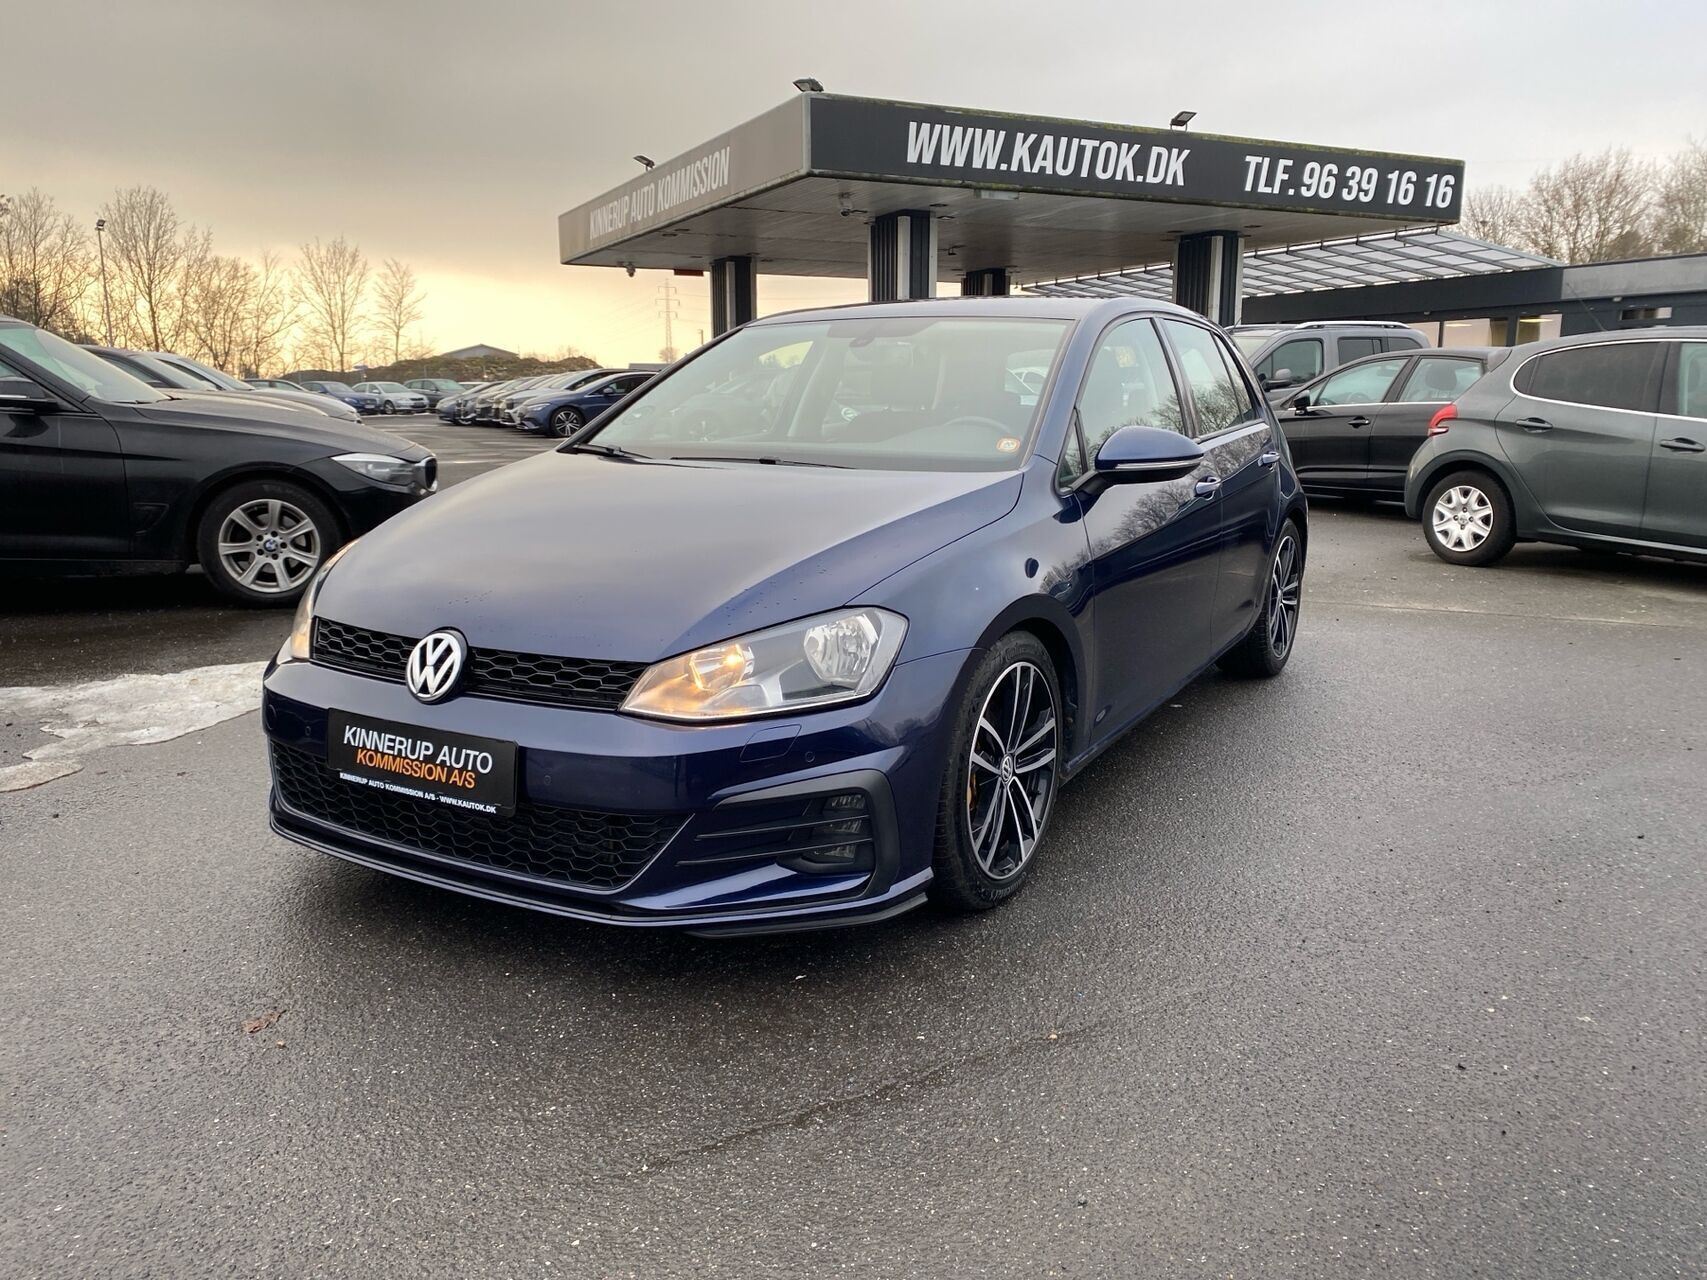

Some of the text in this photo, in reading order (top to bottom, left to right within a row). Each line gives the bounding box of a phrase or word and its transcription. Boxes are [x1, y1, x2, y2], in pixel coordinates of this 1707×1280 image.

[907, 121, 1191, 186] WWW.KAUTOK.DK
[590, 146, 730, 240] KINNERUP AUTO KOMMISSION
[1244, 155, 1456, 208] TLF. 96 39 16 16
[343, 725, 493, 774] KINNERUP AUTO
[356, 749, 476, 789] KOMMISSION A/S
[340, 772, 368, 785] KINNERUP
[368, 779, 385, 789] AUTO
[385, 783, 424, 798] KOMMISSION
[424, 791, 436, 801] A/S
